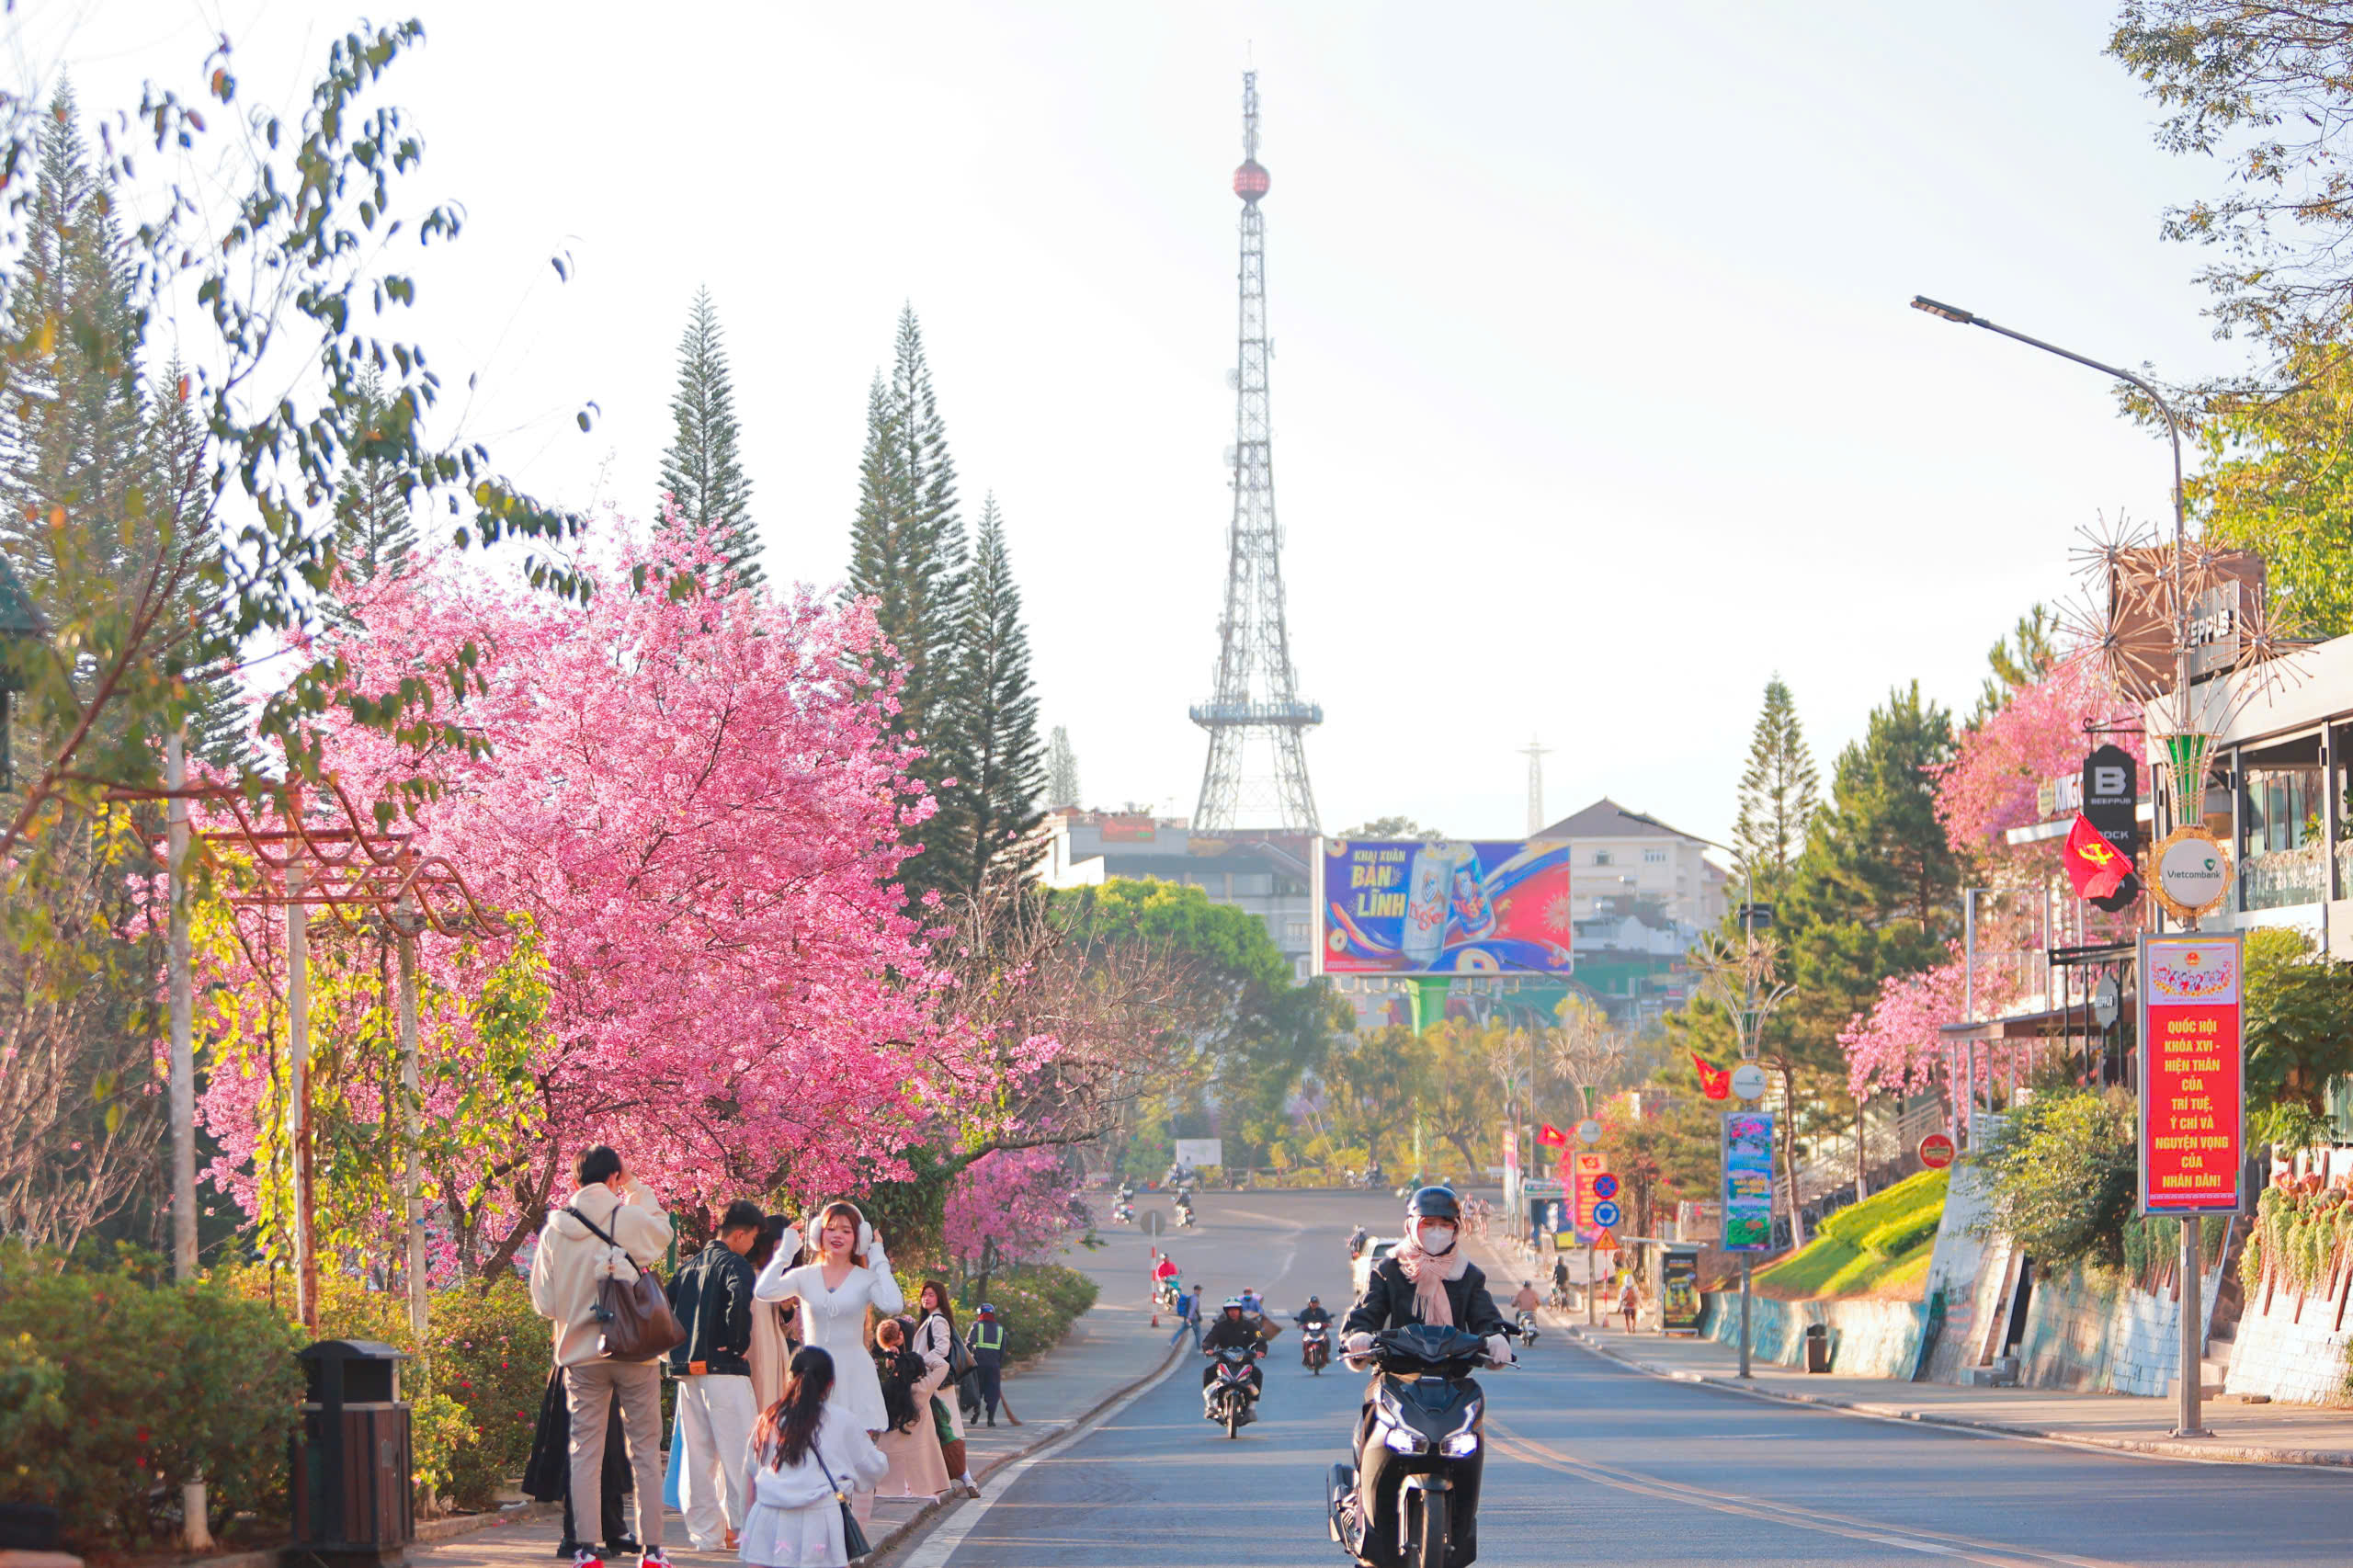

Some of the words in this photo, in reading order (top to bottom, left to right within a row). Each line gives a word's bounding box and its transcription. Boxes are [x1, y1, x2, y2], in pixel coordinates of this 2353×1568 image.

[2186, 610, 2231, 647] EPPUB
[2096, 767, 2126, 794] B
[1353, 850, 1378, 861] KHAI
[1380, 847, 1406, 861] XUÂN
[1351, 858, 1392, 888] BẢN
[2167, 869, 2221, 879] Vietcombank
[1357, 889, 1406, 917] LĨNH
[1452, 896, 1486, 919] Tige
[1408, 901, 1446, 931] Tiger
[2167, 1017, 2197, 1034] QUỐC
[2199, 1018, 2217, 1035] HỘI
[2165, 1038, 2193, 1052] KHÓA
[2196, 1040, 2213, 1052] XVI
[2165, 1057, 2189, 1075] HIỆN
[2192, 1057, 2221, 1072] THÂN
[2181, 1074, 2203, 1091] CỦA
[2171, 1096, 2188, 1110] TRÍ
[2191, 1096, 2213, 1112] TUỆ,
[2170, 1115, 2177, 1130] Ý
[2179, 1114, 2198, 1130] CHÍ
[2200, 1115, 2214, 1130] VÀ
[2155, 1134, 2198, 1152] NGUYỆN
[2200, 1136, 2229, 1152] VỌNG
[2181, 1152, 2203, 1168] CỦA
[2163, 1173, 2192, 1188] NHÂN
[2195, 1172, 2221, 1187] DÂN!
